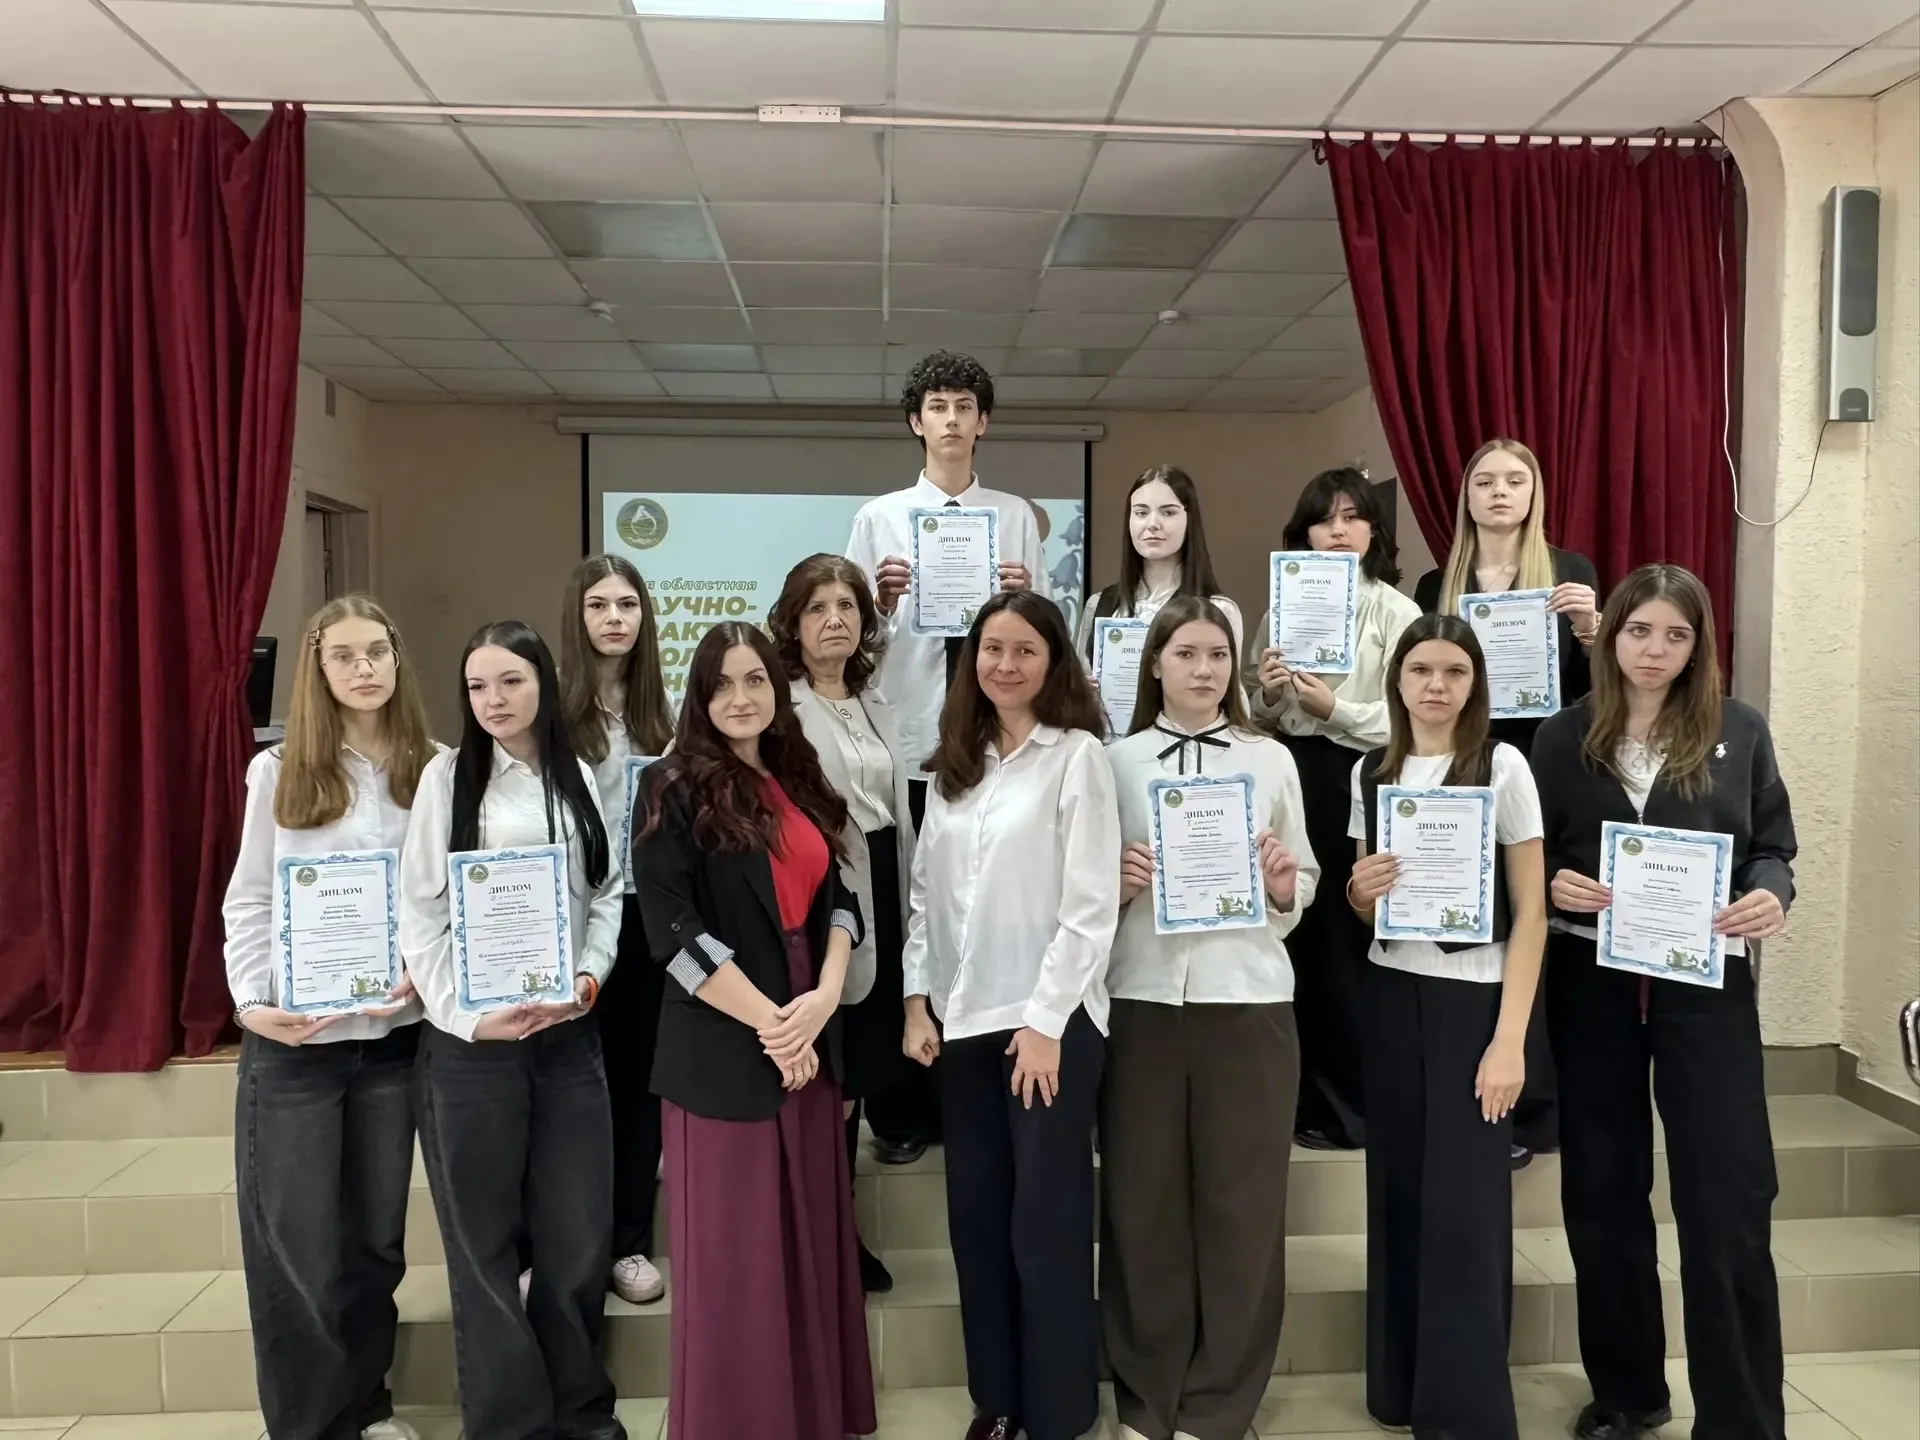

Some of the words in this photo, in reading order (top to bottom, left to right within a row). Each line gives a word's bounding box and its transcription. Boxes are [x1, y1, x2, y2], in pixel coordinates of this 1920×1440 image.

[660, 577, 758, 591] областная
[650, 596, 757, 616] УЧНО-
[1184, 809, 1224, 819] ДИПЛОМ
[1415, 822, 1458, 830] ДИПЛОМ
[1641, 861, 1687, 874] ДИПЛОМ
[318, 887, 363, 898] ДИПЛОМ
[488, 884, 531, 895] ДИПЛОМ
